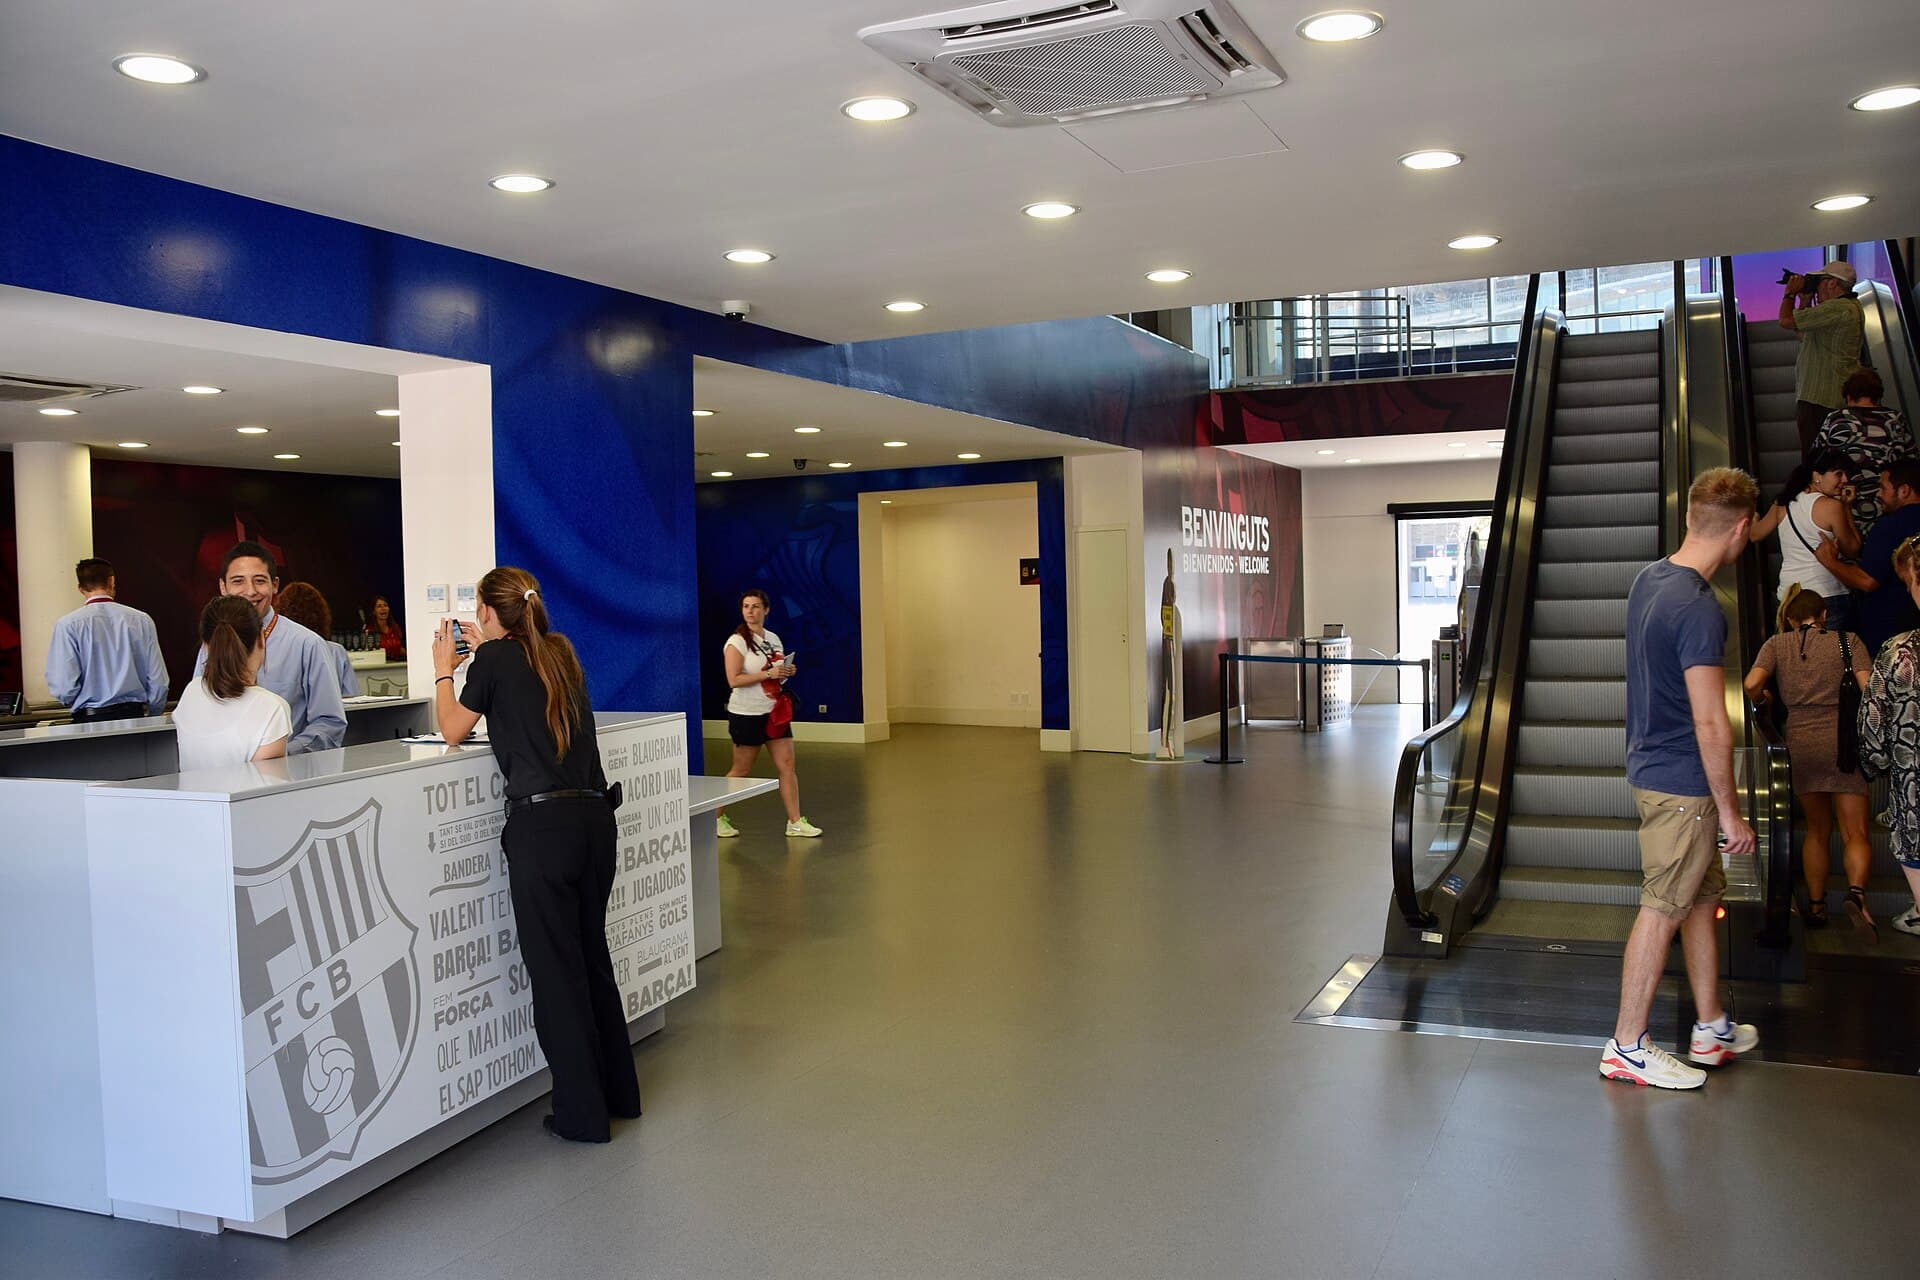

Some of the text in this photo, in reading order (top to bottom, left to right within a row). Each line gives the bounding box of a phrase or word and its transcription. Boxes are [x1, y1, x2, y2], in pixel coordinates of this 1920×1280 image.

[1181, 506, 1270, 552] BENVINGUTS
[1183, 553, 1270, 574] BIENVENIDOS WELCOME
[608, 756, 628, 771] GENT
[632, 735, 682, 766] BLAUGRANA
[423, 780, 459, 815] TOT
[465, 776, 486, 806] EL
[664, 767, 682, 793] UNA
[622, 822, 642, 837] VENT
[647, 798, 683, 830] UN CRIT
[443, 852, 491, 883] BANDERA
[623, 828, 687, 873] BARÇA!
[632, 863, 686, 905] JUGADORS
[429, 896, 485, 941] VALENT
[659, 904, 688, 929] GOLS
[433, 934, 492, 984] BARÇA!
[637, 930, 688, 964] BLAUGRANA
[663, 943, 689, 966] AL VENT
[433, 991, 453, 1009] FEM
[626, 963, 692, 1018] BARÇA!
[434, 991, 494, 1032] FORÇA
[437, 1036, 462, 1073] QUE
[468, 1018, 498, 1059] MAI
[439, 1041, 536, 1116] EL SAP TOTHOM
